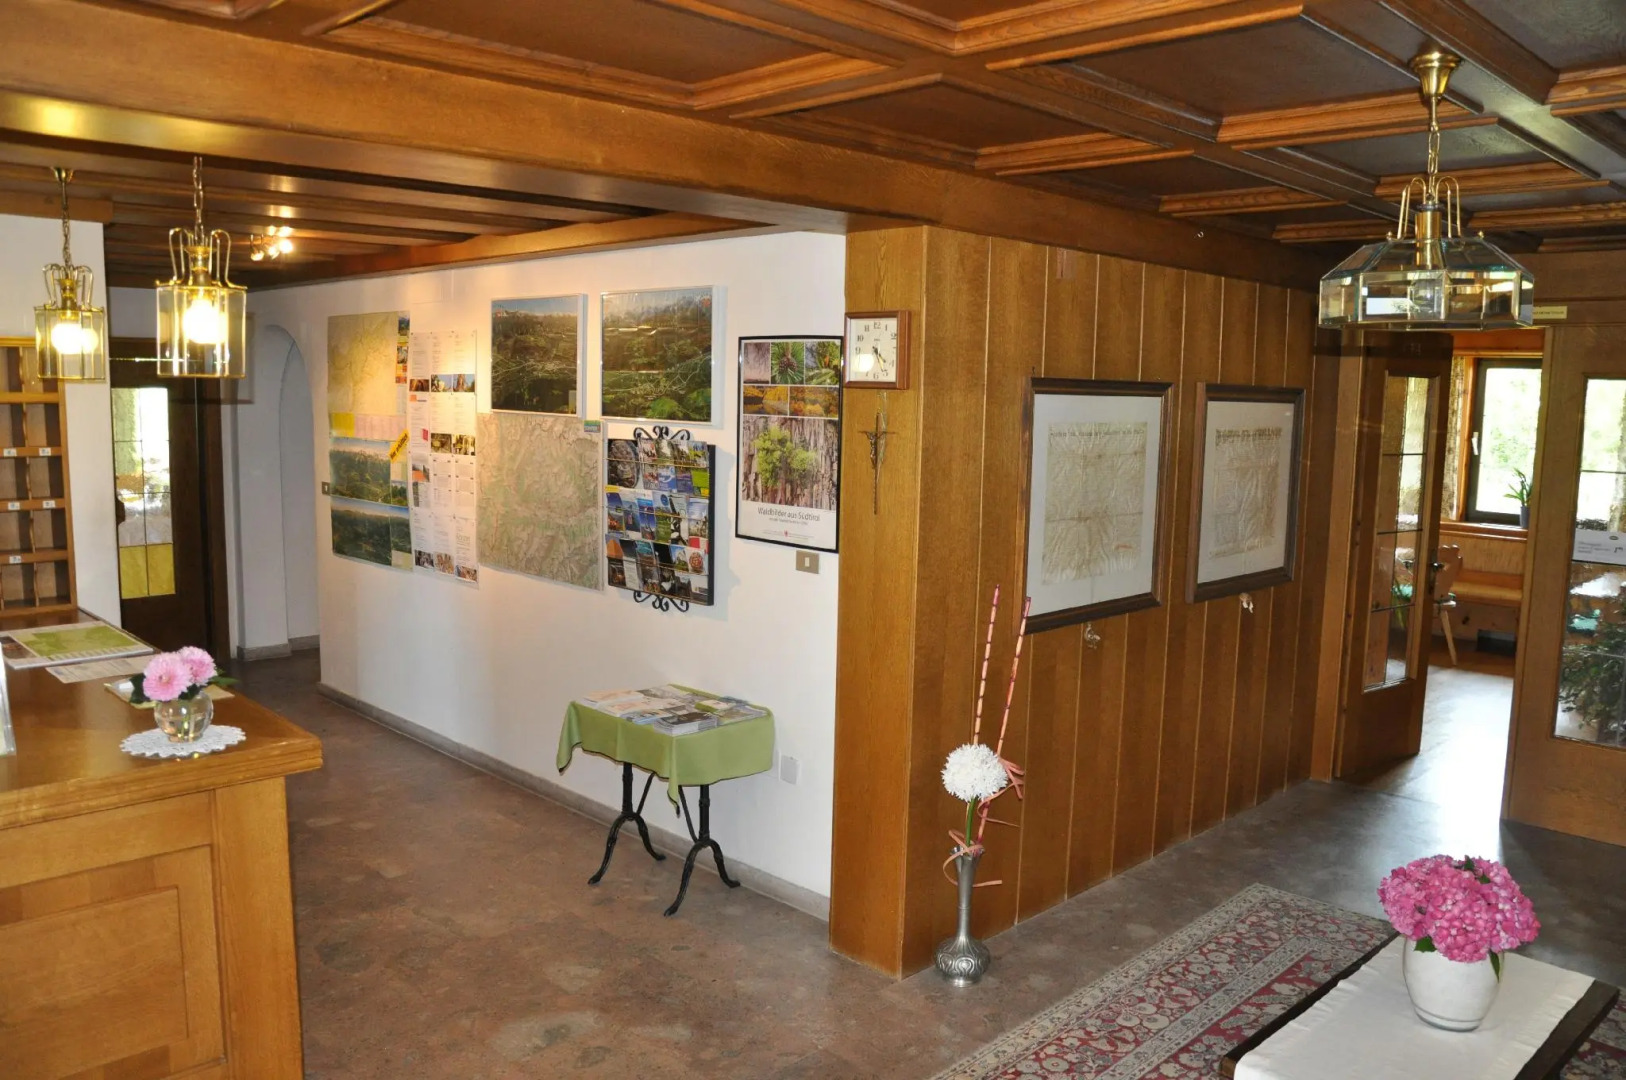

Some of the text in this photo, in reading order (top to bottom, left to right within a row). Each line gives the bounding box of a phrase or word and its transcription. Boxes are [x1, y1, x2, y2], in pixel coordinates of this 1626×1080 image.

[873, 321, 881, 330] 12
[757, 507, 821, 521] Waldbilder aus Südtirol
